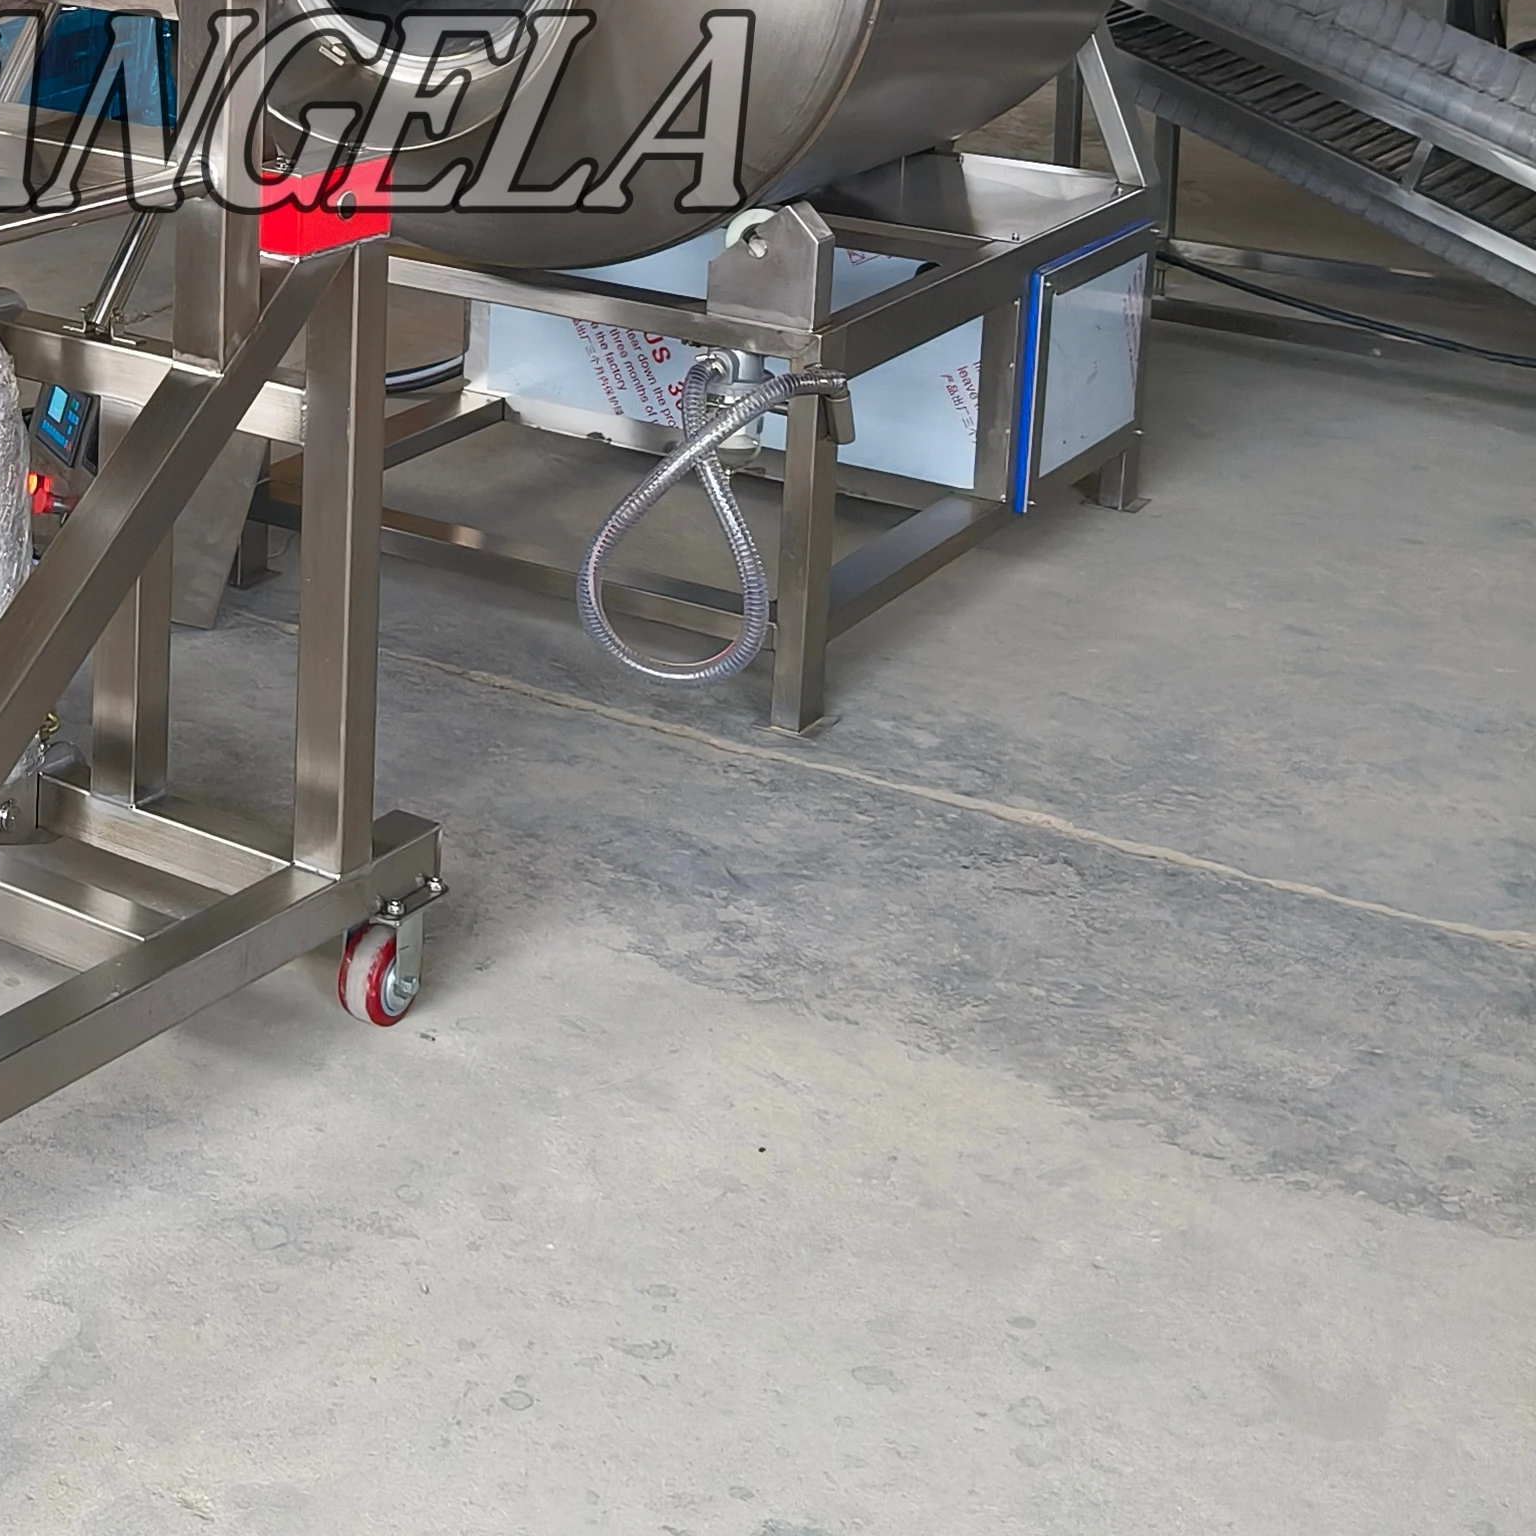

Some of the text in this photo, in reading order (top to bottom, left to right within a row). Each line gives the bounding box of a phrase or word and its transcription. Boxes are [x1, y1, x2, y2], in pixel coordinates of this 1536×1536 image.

[595, 331, 626, 391] the factory
[610, 329, 658, 416] three months of
[638, 353, 657, 385] down
[654, 387, 666, 406] the
